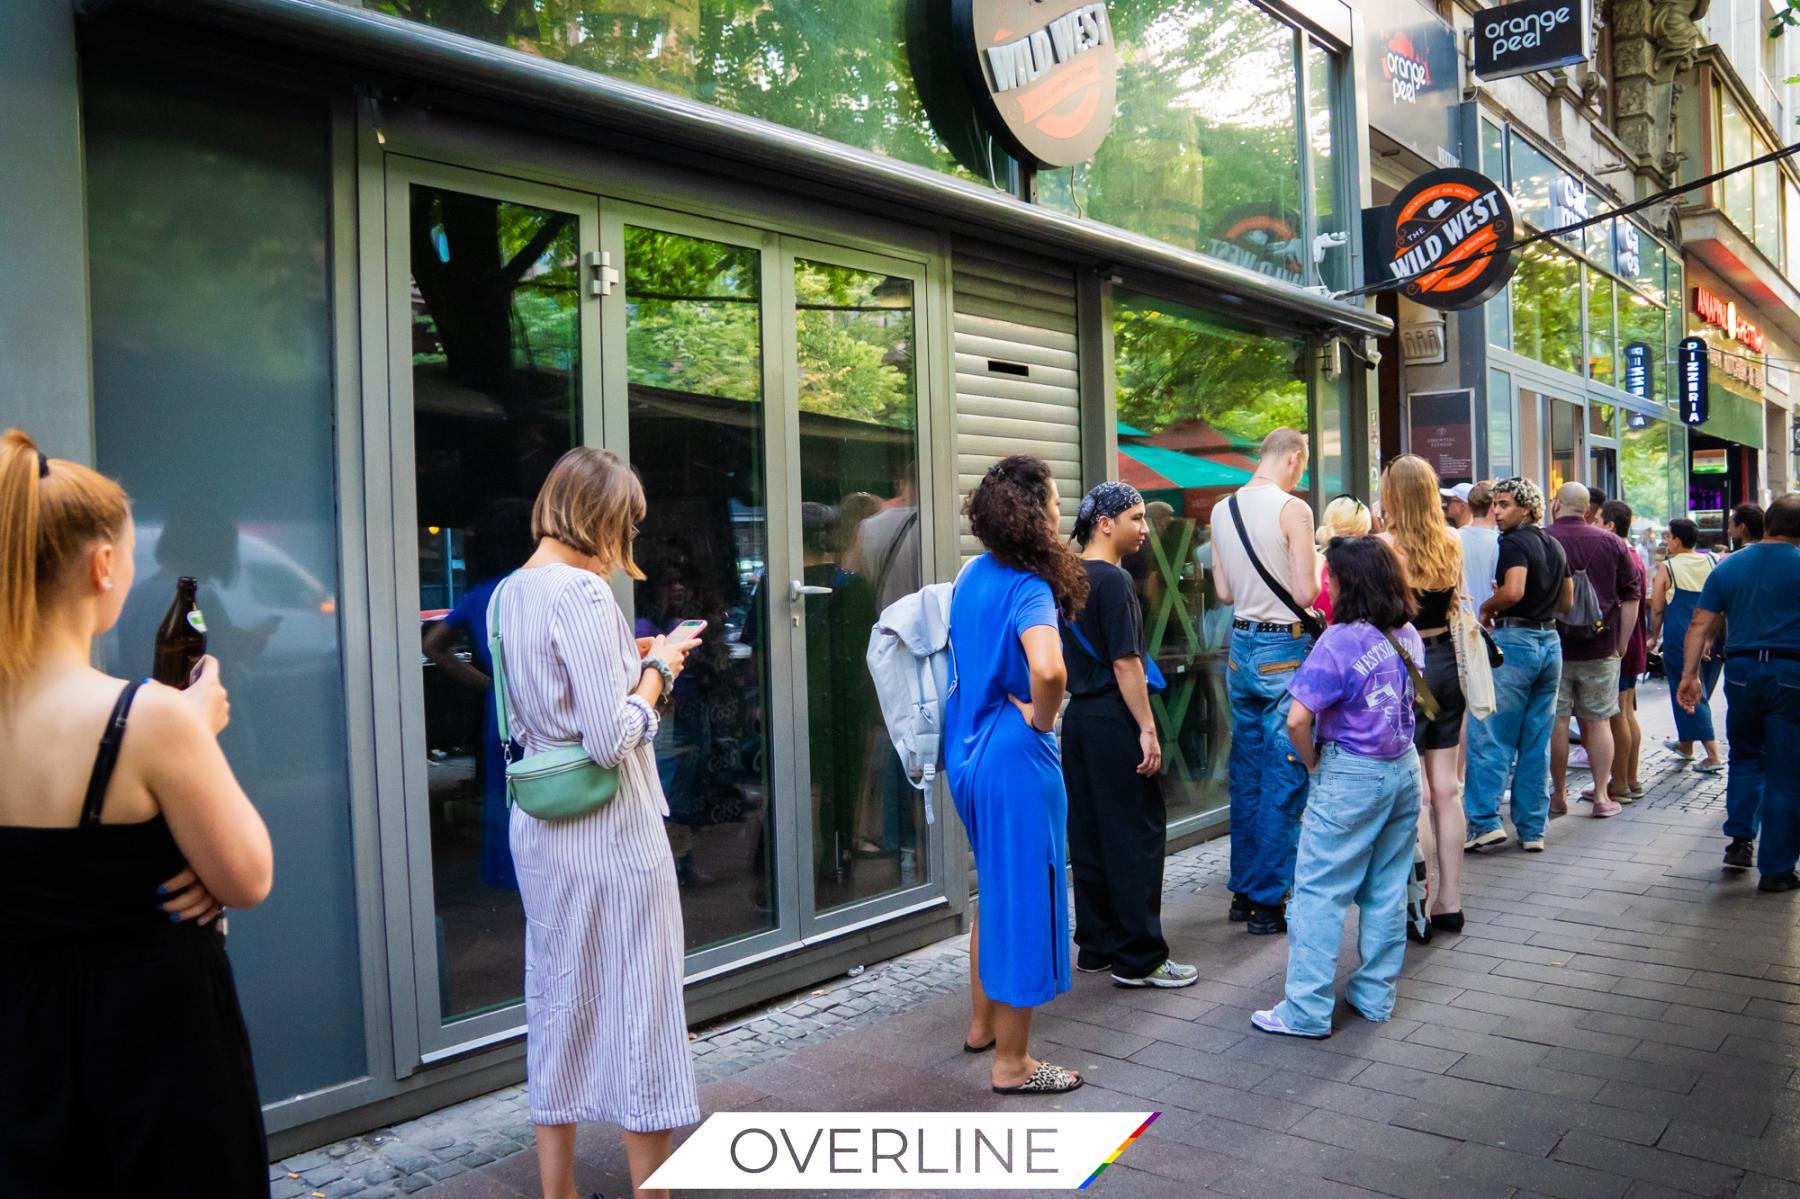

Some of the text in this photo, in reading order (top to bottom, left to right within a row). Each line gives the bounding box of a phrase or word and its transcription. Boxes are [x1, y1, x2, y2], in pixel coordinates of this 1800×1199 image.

[1485, 7, 1570, 39] orange
[986, 29, 1053, 92] WILD
[1049, 3, 1108, 64] WEST
[1492, 29, 1541, 61] peel
[1387, 52, 1427, 90] orange
[1392, 77, 1416, 104] peel
[1389, 234, 1443, 282] WILD
[1442, 190, 1500, 246] WEST
[1407, 226, 1426, 242] THE
[1686, 342, 1700, 422] PIZZERIA
